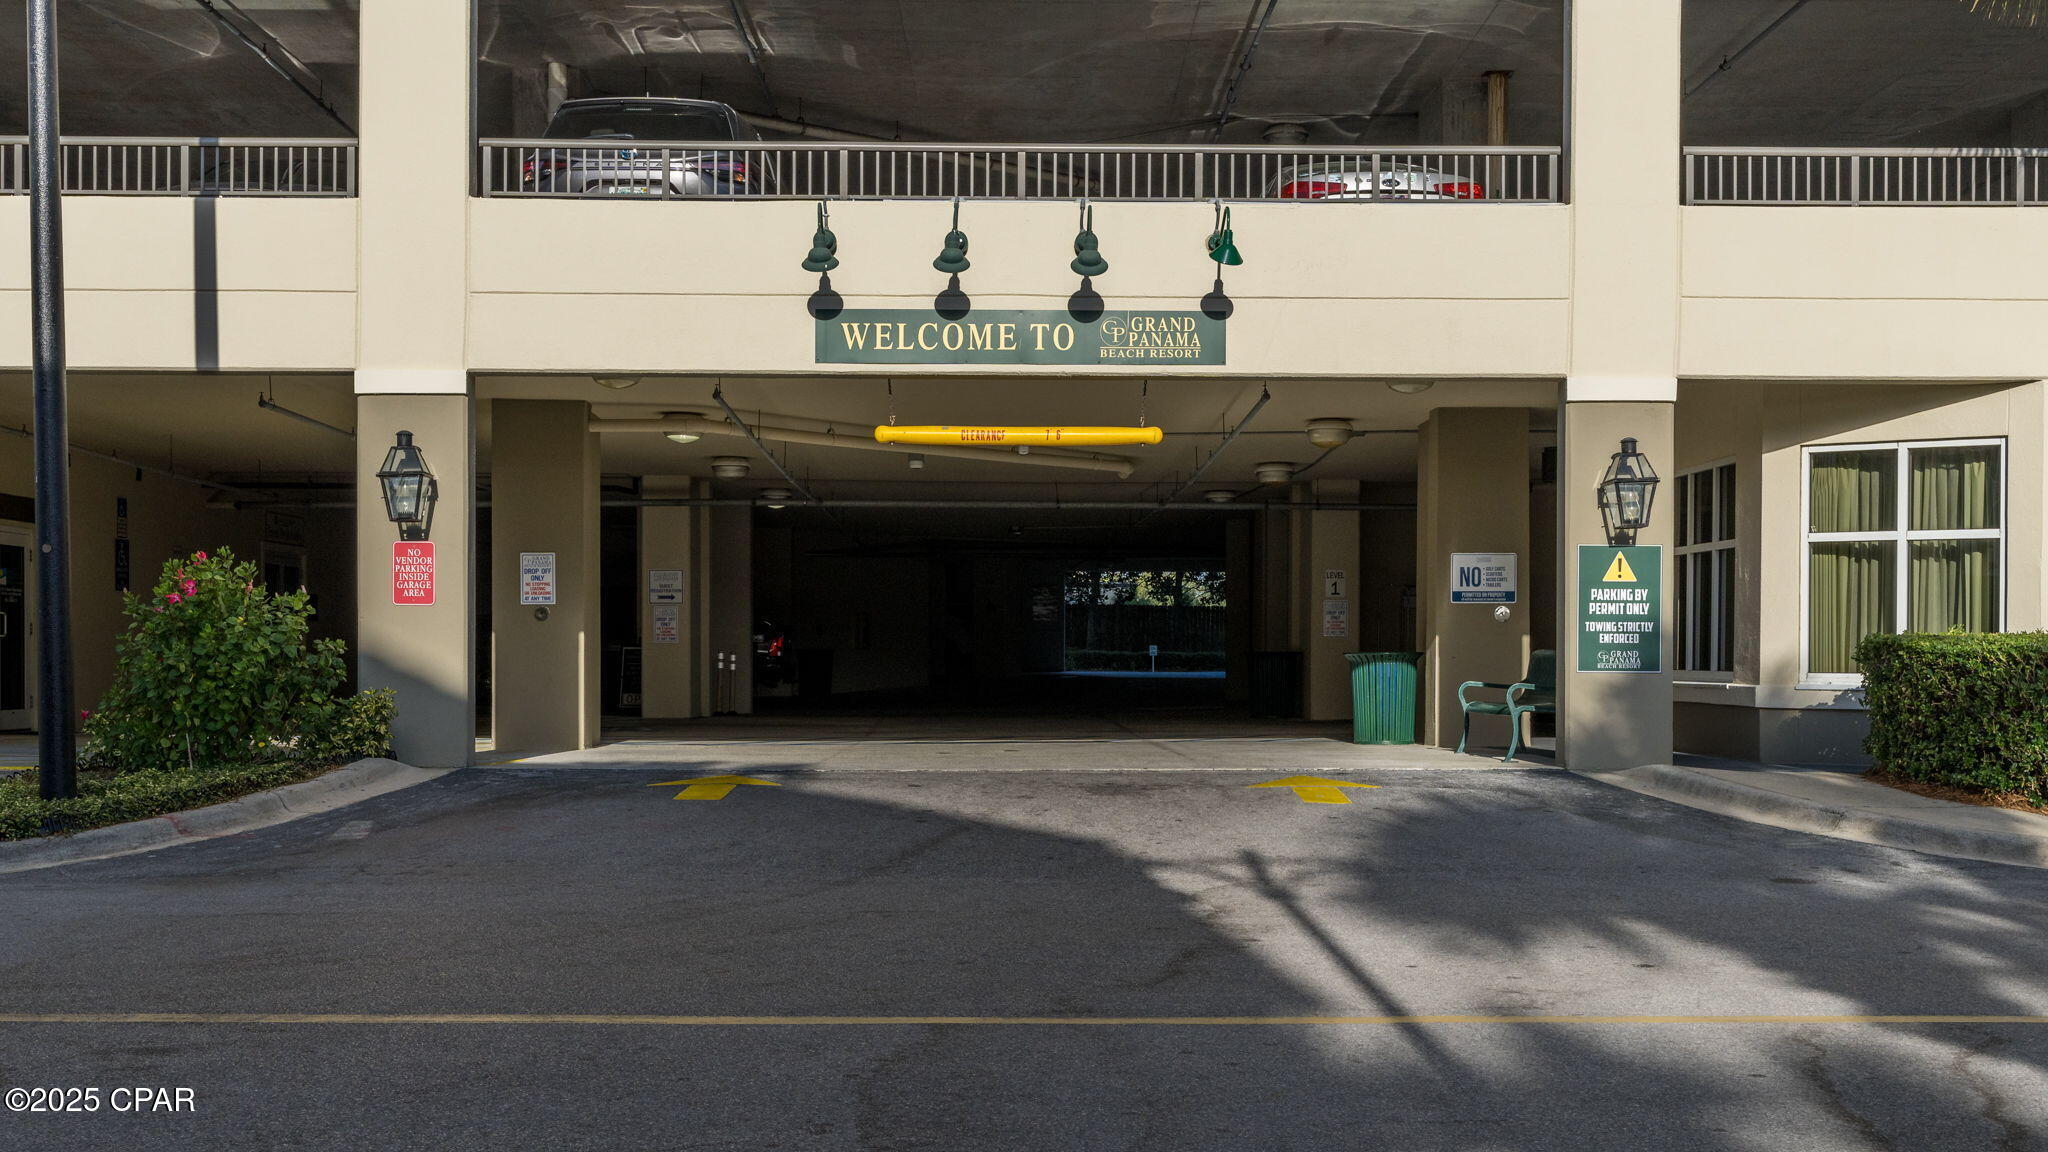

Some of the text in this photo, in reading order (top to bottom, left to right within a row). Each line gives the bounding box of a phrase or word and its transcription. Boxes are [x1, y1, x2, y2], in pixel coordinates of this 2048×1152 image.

[1131, 316, 1196, 332] GRAND
[841, 322, 1075, 351] WELCOME TO
[1129, 332, 1201, 347] PANAMA
[1100, 349, 1201, 358] BEACH RESORT
[407, 548, 421, 557] NO
[395, 556, 433, 565] VENDOR
[395, 564, 433, 573] PARKING
[399, 572, 429, 581] INSIDE
[1326, 571, 1345, 579] LEVEL
[1459, 566, 1482, 587] NO
[396, 580, 432, 589] GARAGE
[1330, 581, 1341, 596] 1
[403, 589, 425, 597] AREA
[1591, 589, 1648, 601] PARKING BY
[1589, 602, 1649, 615] PERMIT ONLY
[1585, 621, 1654, 632] TOWING STRICTLY
[1599, 633, 1640, 644] ENFORCED
[1610, 650, 1639, 658] GRAND
